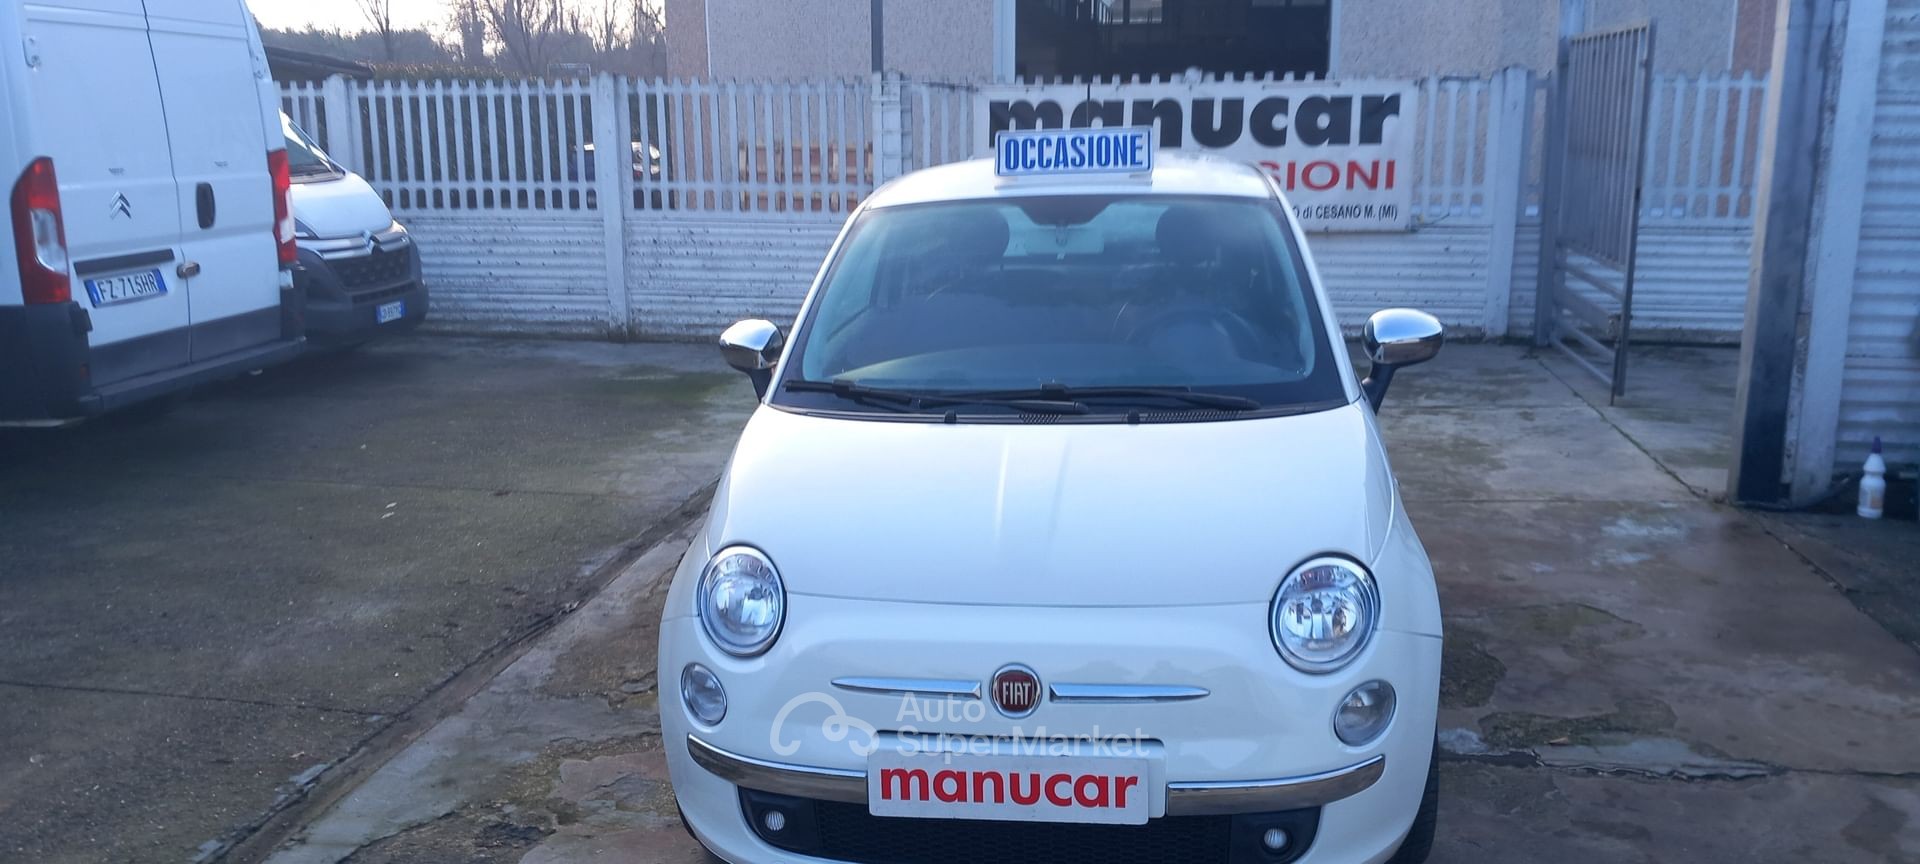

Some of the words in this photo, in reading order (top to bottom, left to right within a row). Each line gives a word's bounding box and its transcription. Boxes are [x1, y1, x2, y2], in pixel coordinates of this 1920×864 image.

[989, 94, 1400, 148] manucar
[1005, 134, 1143, 170] OCCASIONE
[1303, 205, 1312, 219] di
[1315, 205, 1361, 219] CESANO
[1364, 204, 1376, 219] M.
[1379, 204, 1398, 221] (MI)
[1002, 681, 1031, 705] FIAT
[880, 767, 1139, 809] manucar
